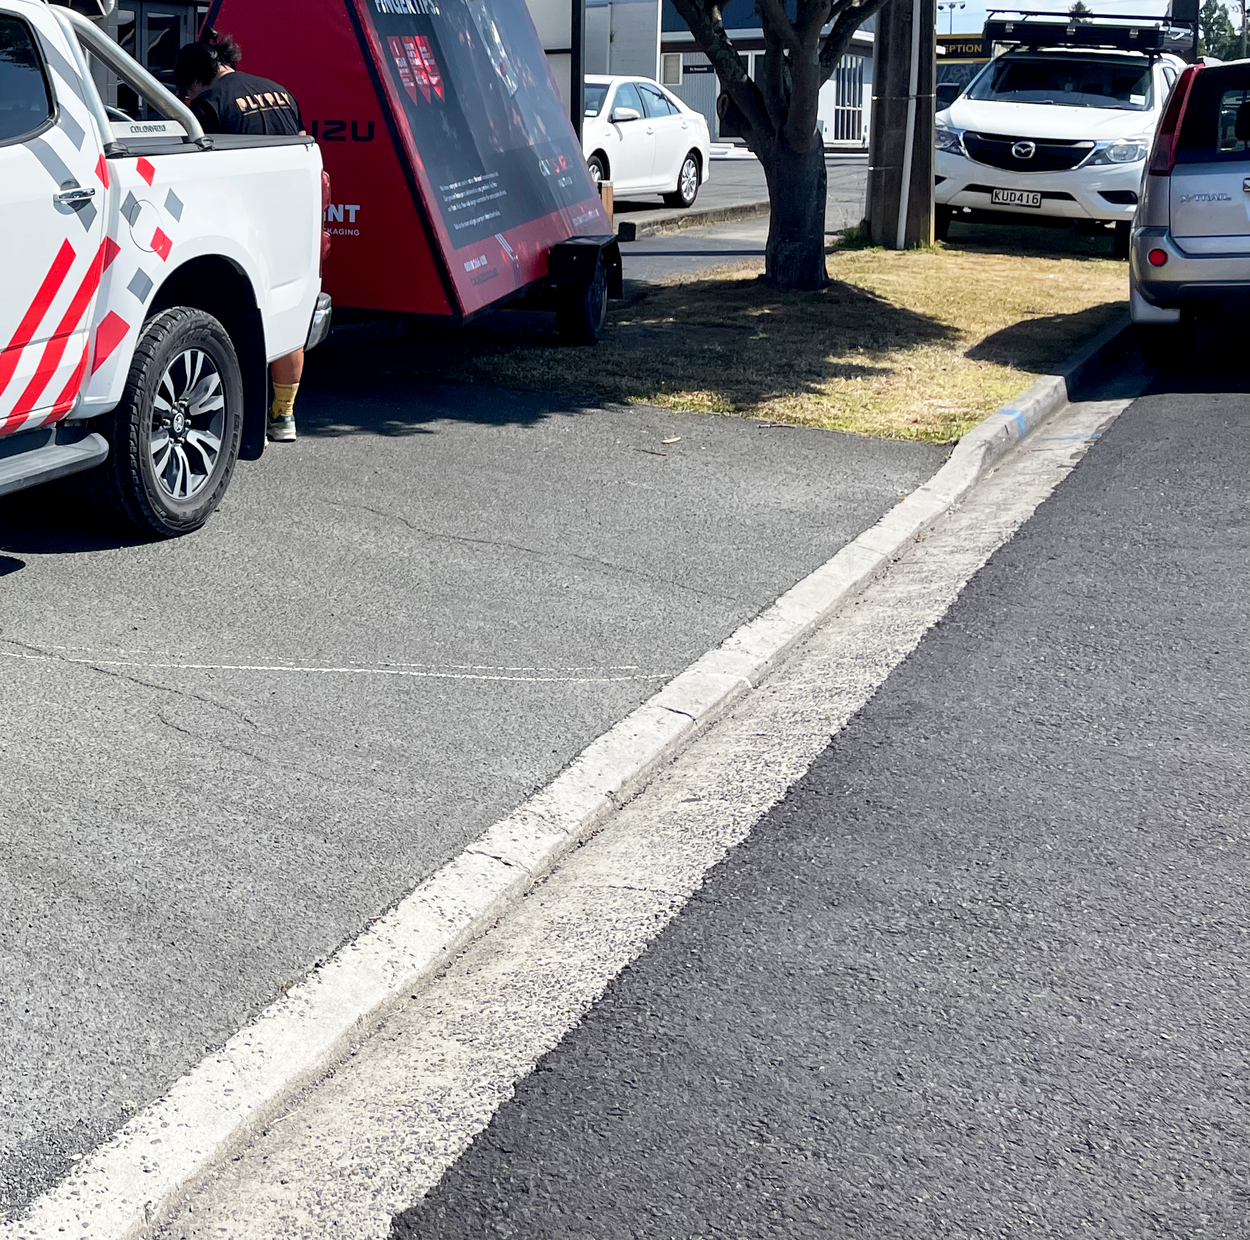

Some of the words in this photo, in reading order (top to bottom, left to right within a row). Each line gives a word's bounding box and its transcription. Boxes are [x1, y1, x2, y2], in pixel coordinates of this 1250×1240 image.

[236, 91, 291, 112] PLYPLY
[994, 190, 1039, 205] KUD416
[1180, 192, 1232, 203] X-TRAIL
[325, 227, 361, 237] KAGING
